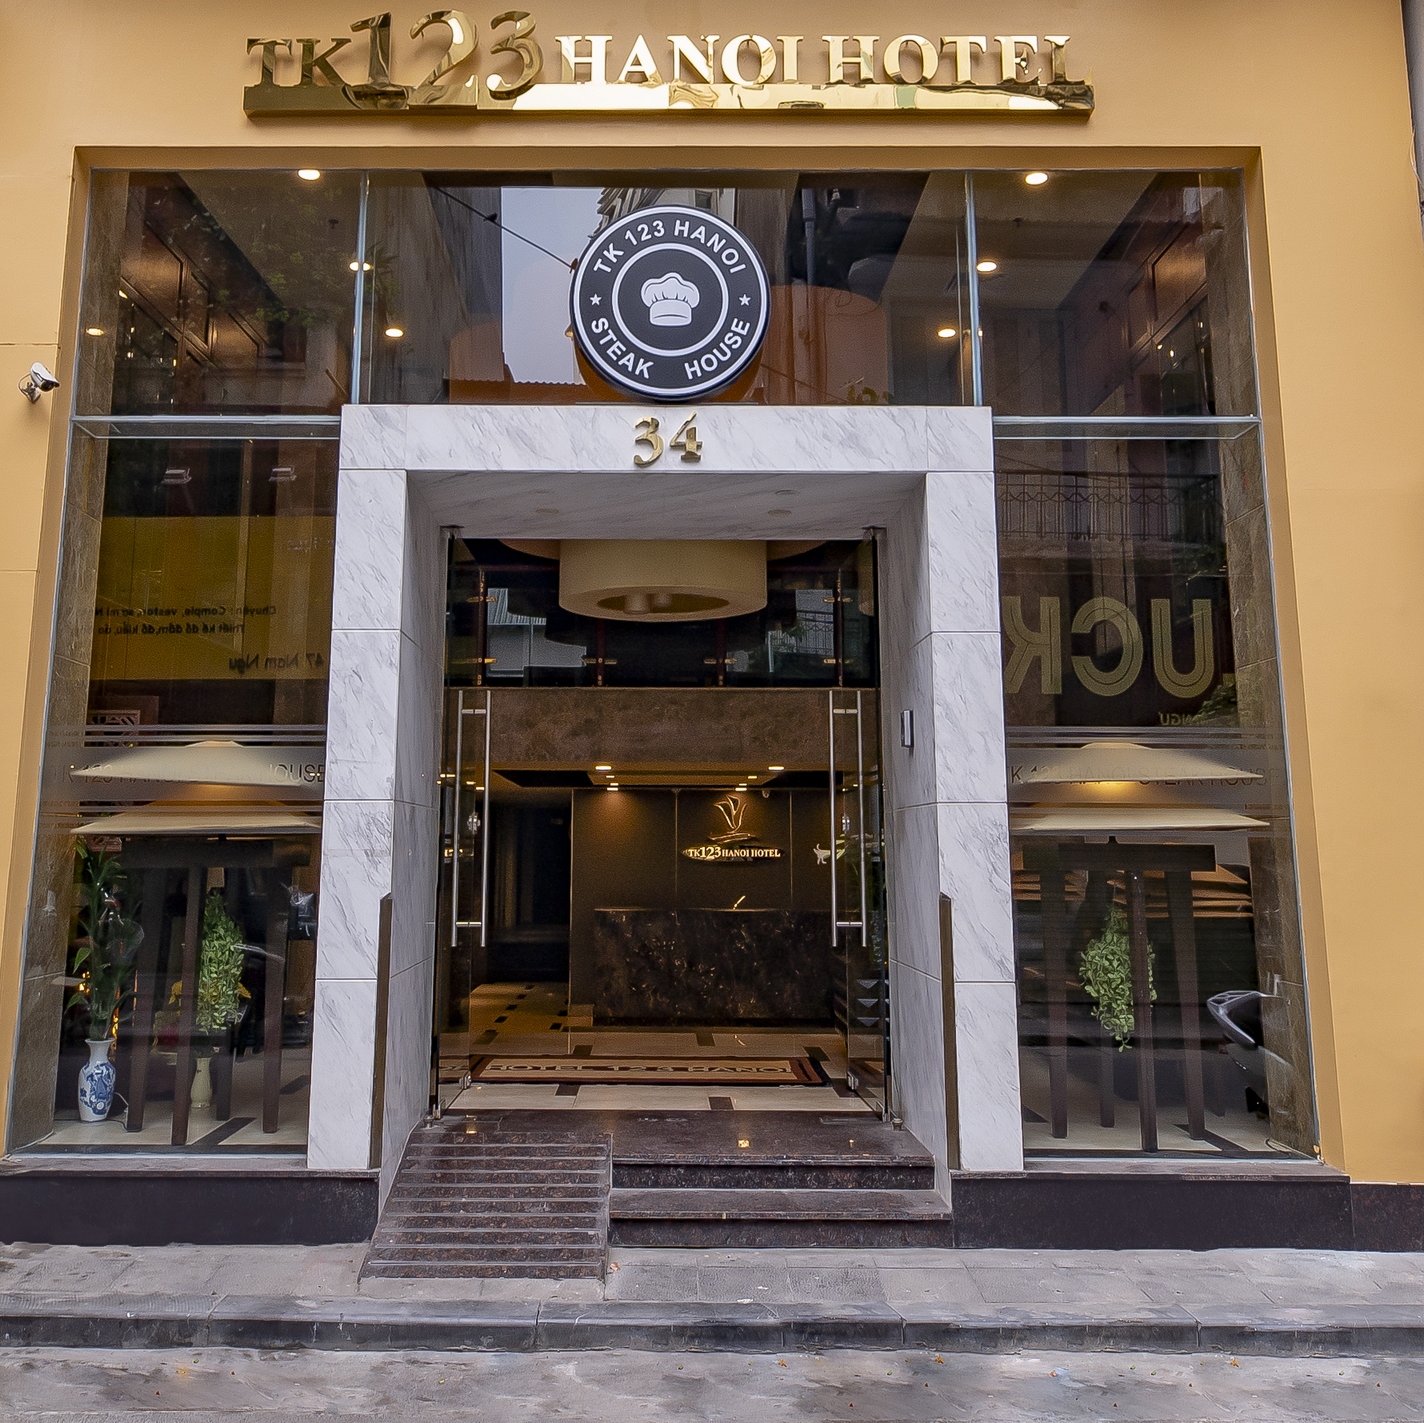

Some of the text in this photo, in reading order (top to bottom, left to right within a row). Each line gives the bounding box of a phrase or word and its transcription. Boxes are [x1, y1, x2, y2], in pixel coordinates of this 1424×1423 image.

[554, 34, 805, 87] HANOI
[823, 34, 1073, 87] HOTEL
[593, 219, 747, 275] TK 123 HANOI
[591, 317, 751, 380] STEAK HOUSE
[632, 411, 704, 468] 34
[722, 849, 749, 857] HANOI
